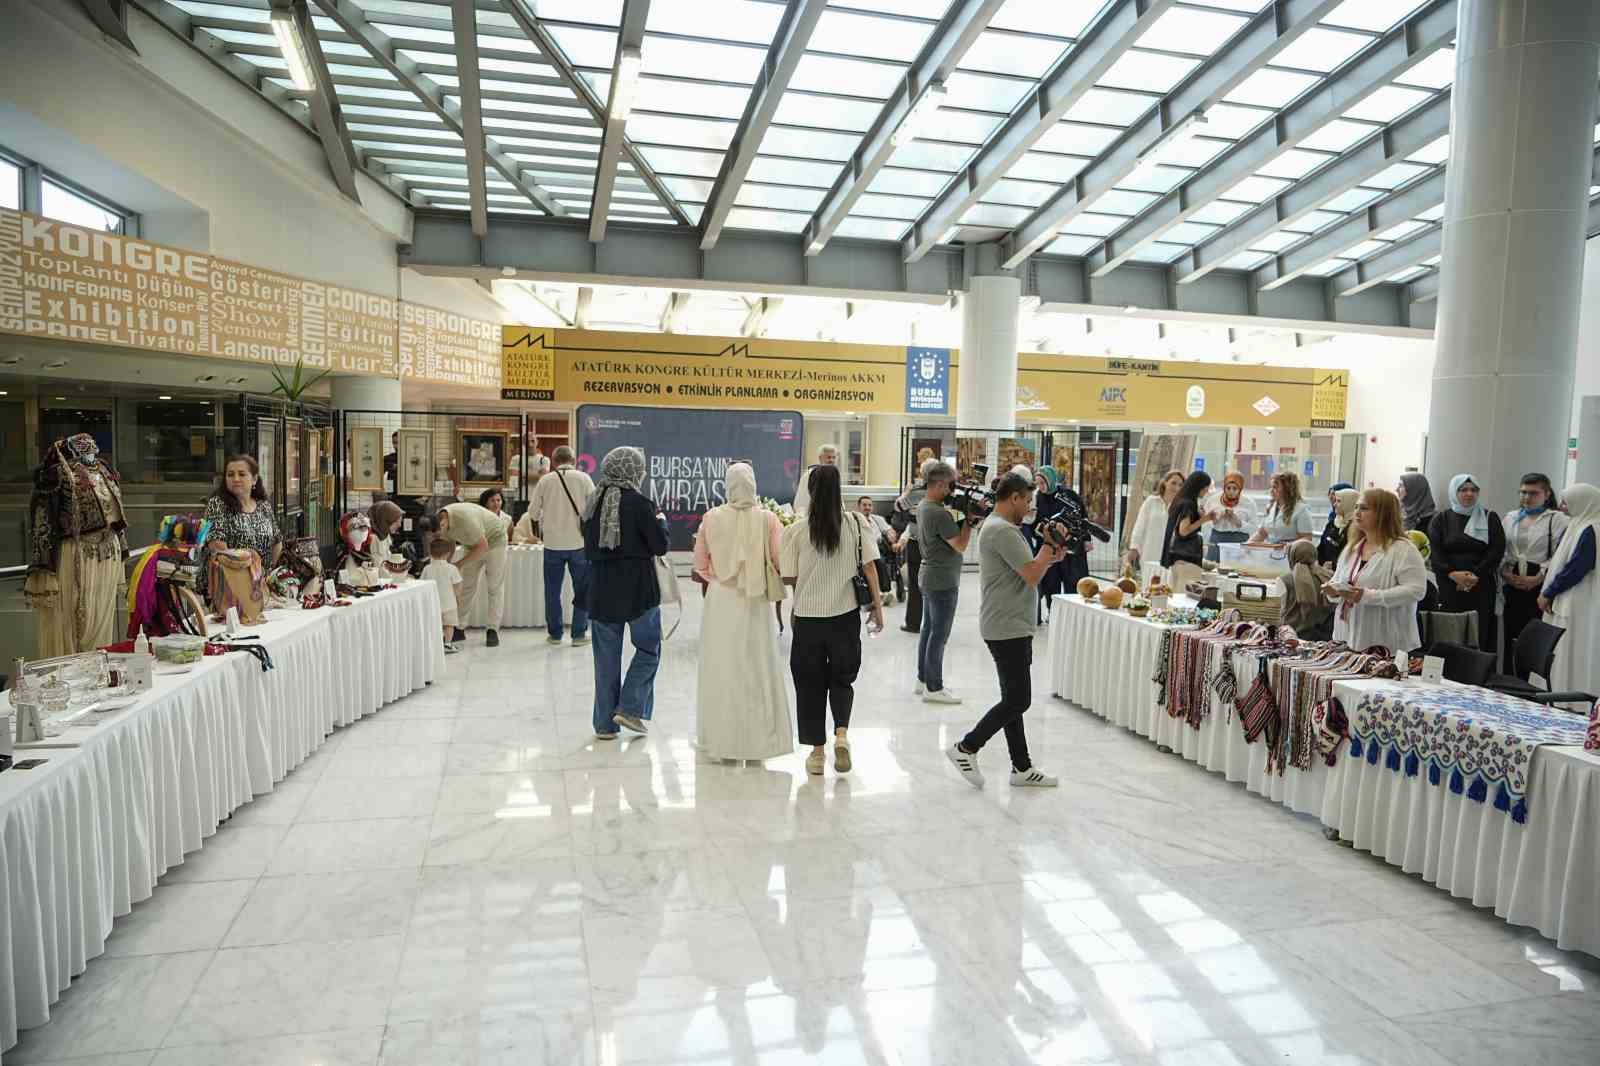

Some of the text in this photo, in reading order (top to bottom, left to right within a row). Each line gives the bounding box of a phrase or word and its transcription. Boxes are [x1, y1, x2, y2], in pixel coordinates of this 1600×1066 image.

[23, 251, 129, 284] Toplantı
[136, 273, 194, 299] Düğün
[210, 271, 288, 304] Gösteri
[24, 290, 195, 337] Exhibition
[137, 292, 194, 314] Konser
[211, 303, 282, 328] Show
[127, 329, 195, 352] Tiyatro
[211, 334, 300, 364] Lansman
[328, 350, 382, 373] Fuar
[572, 360, 632, 374] ATATÜRK
[635, 363, 689, 376] KONGRE
[693, 365, 744, 378] KÜLTÜR
[851, 373, 886, 384] AKKM
[583, 381, 874, 401] REZERVASYON ETKİNLİK PLANLAMA ORGANİZASYON
[910, 387, 943, 397] BURSA
[650, 456, 732, 479] BURSA'NIN
